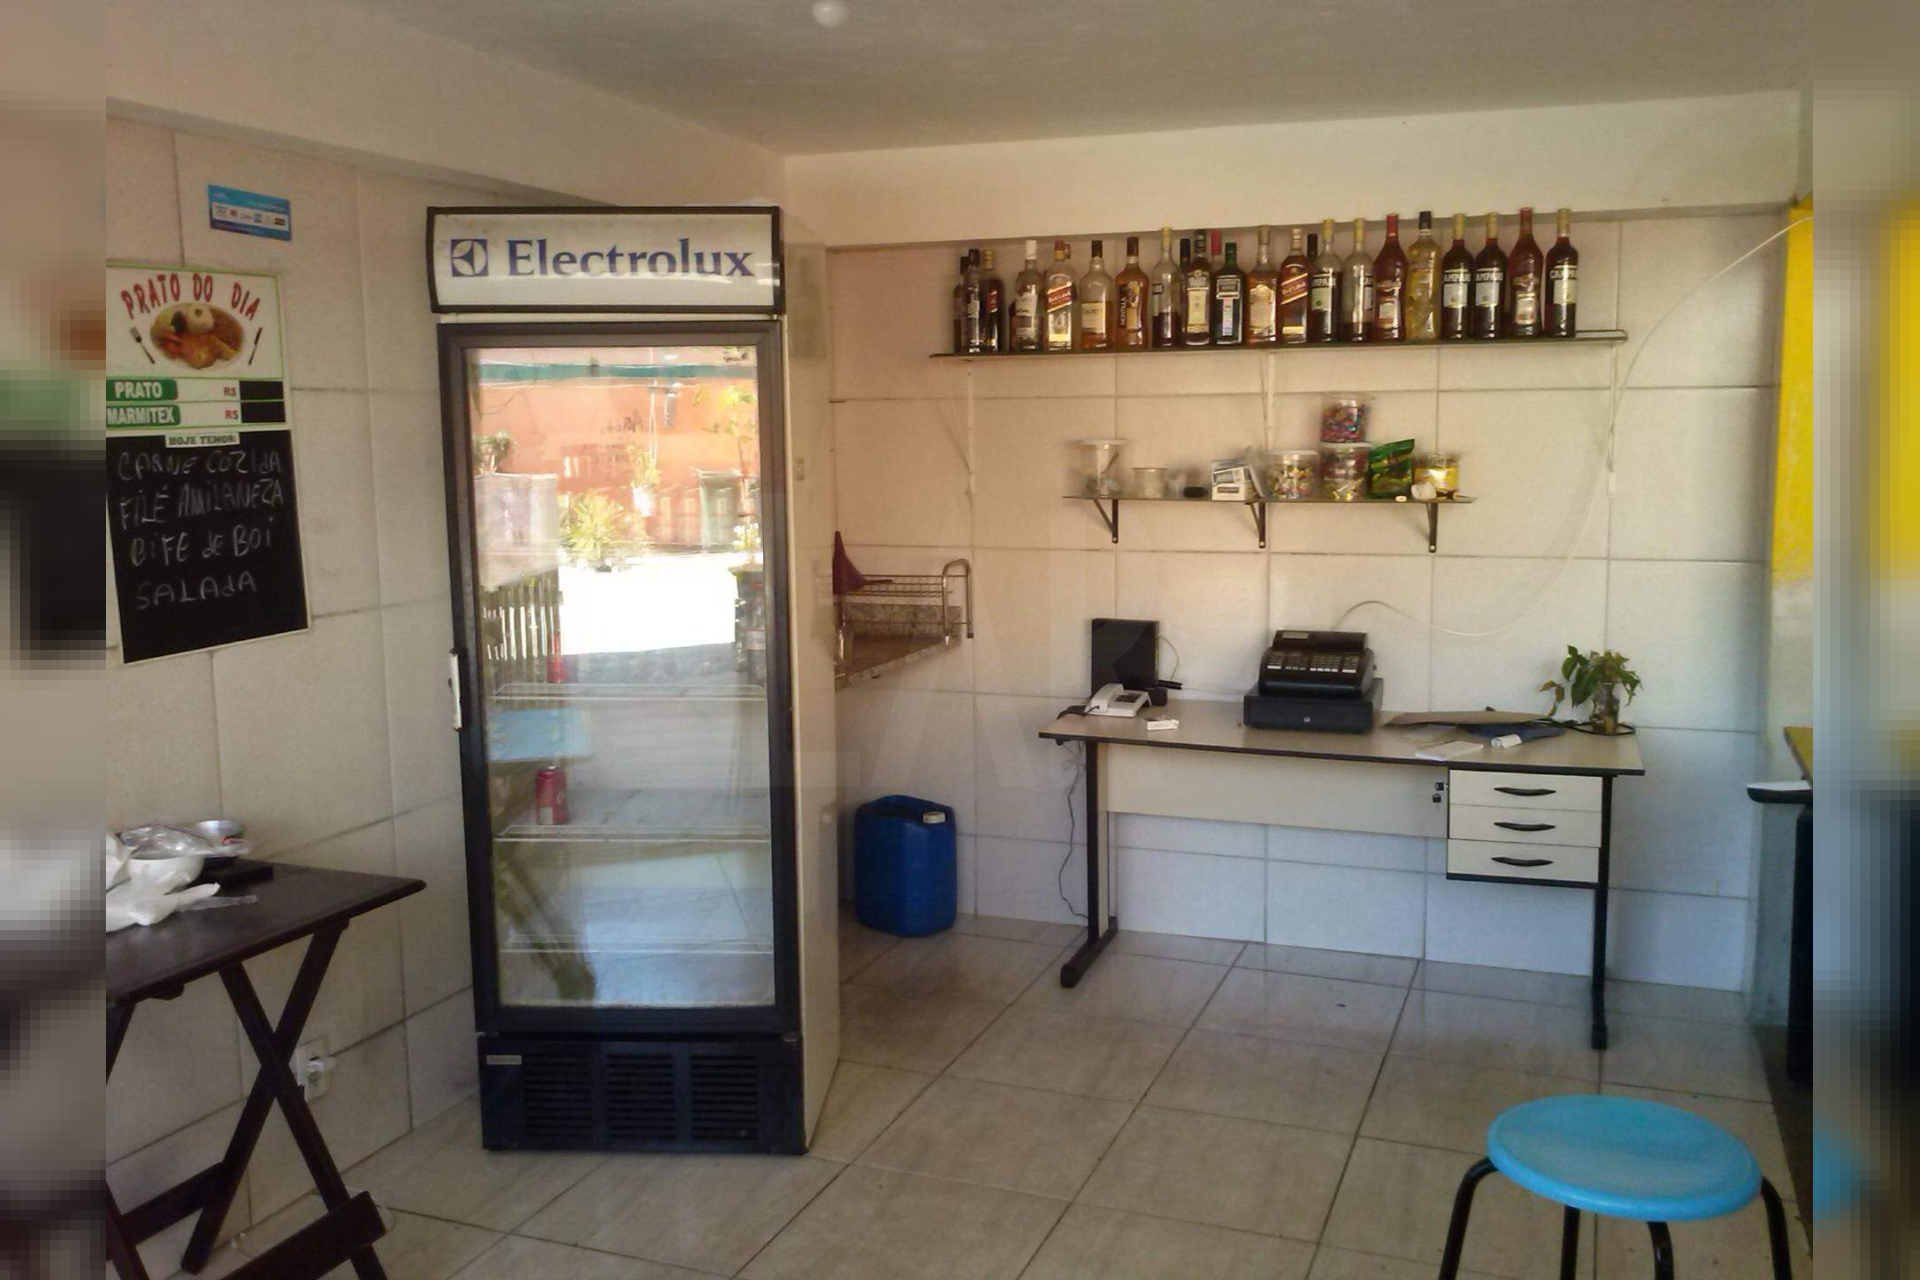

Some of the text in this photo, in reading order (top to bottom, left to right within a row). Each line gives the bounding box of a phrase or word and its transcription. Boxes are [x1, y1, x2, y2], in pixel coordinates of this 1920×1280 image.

[507, 237, 756, 278] Electrolux
[120, 272, 261, 321] PRATO DO DIA
[115, 381, 163, 398] PRATO
[106, 407, 175, 424] MARMITEX
[169, 434, 237, 446] HOJE TEMOS:
[118, 451, 198, 481] CARNE
